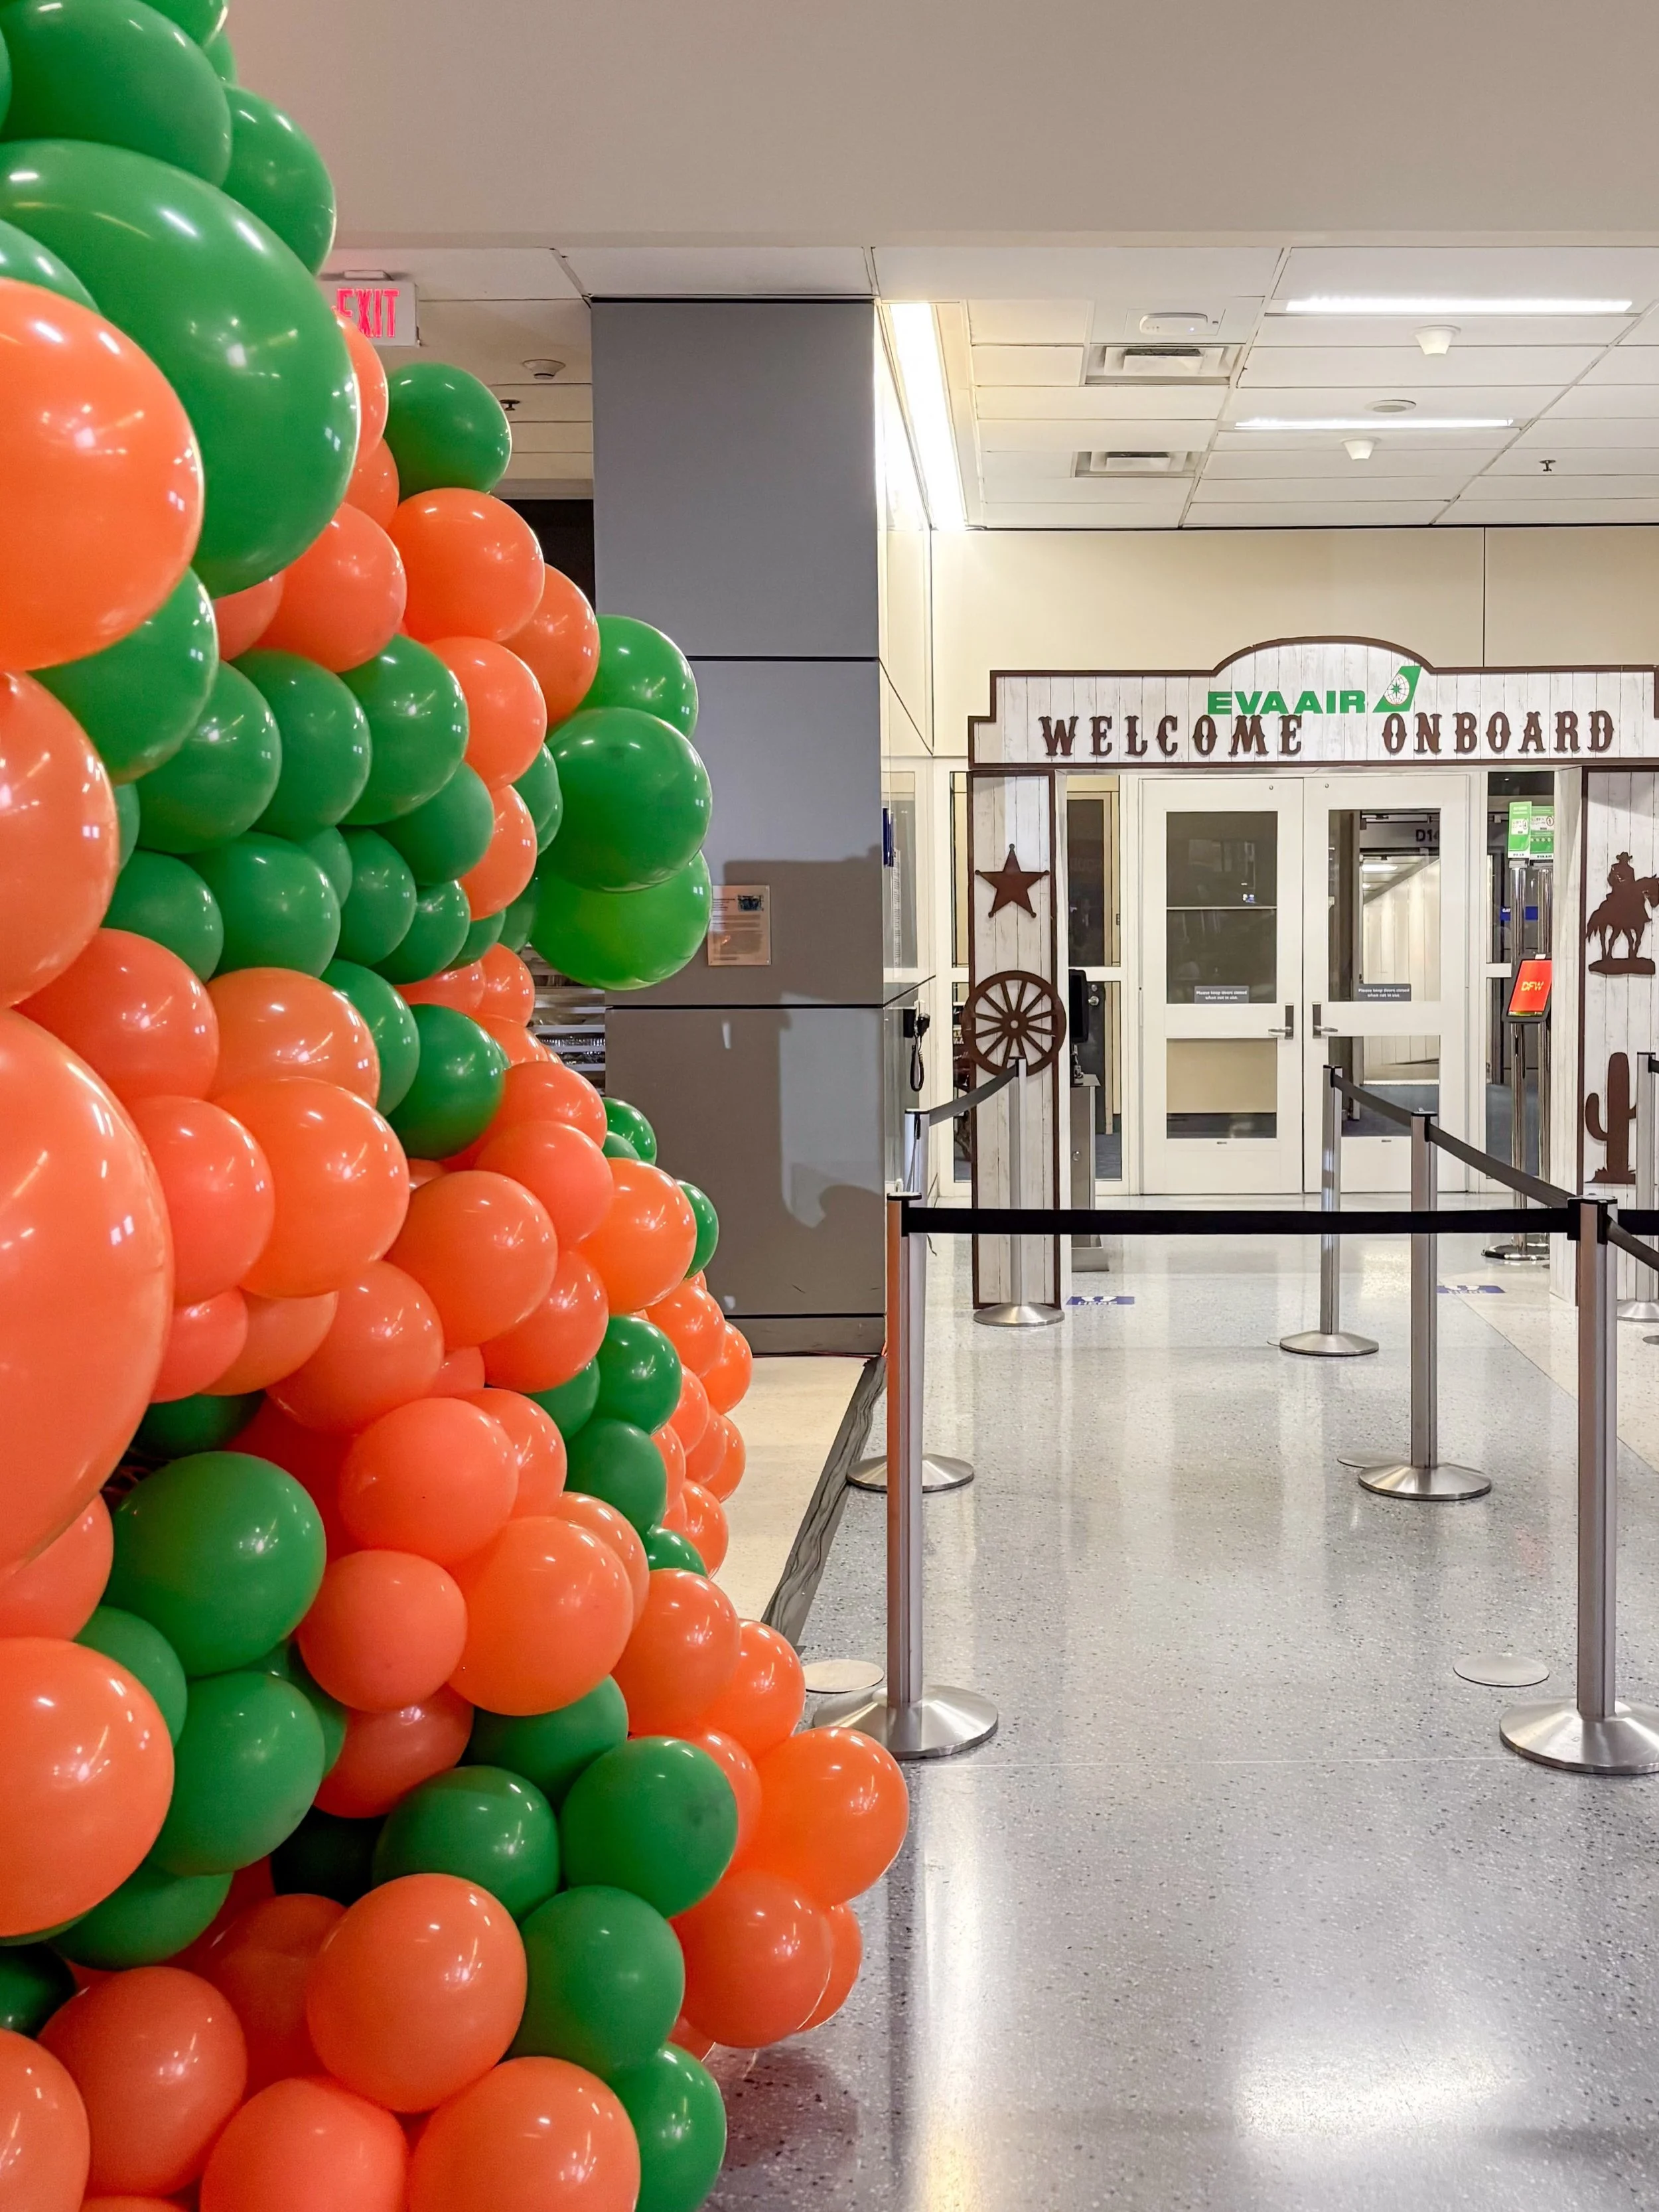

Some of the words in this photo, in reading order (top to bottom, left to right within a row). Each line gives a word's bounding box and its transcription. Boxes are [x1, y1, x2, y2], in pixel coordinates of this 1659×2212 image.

[337, 287, 399, 338] EXIT
[1038, 714, 1302, 757] WELCOME
[1381, 711, 1615, 754] ONBOARD
[1521, 982, 1544, 992] DFW
